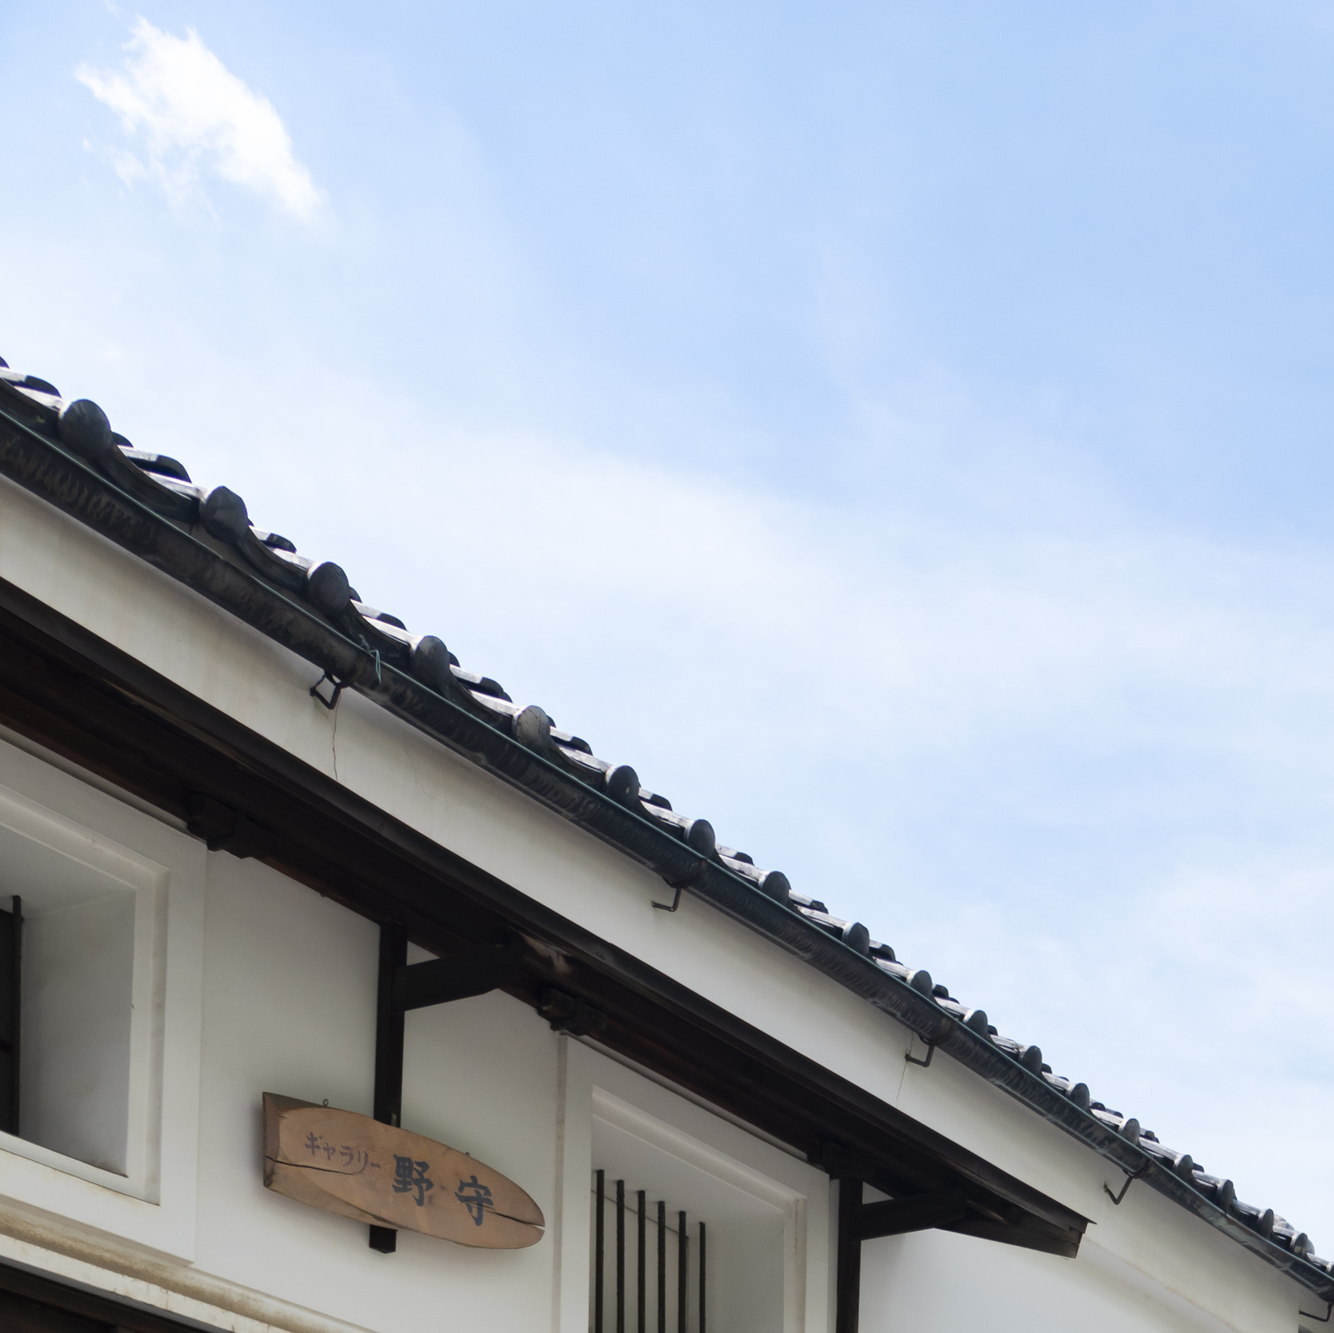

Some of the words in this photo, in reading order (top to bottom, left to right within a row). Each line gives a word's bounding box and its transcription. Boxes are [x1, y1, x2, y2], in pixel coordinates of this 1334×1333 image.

[305, 1132, 382, 1176] ギャラリー
[392, 1153, 495, 1227] 野守
